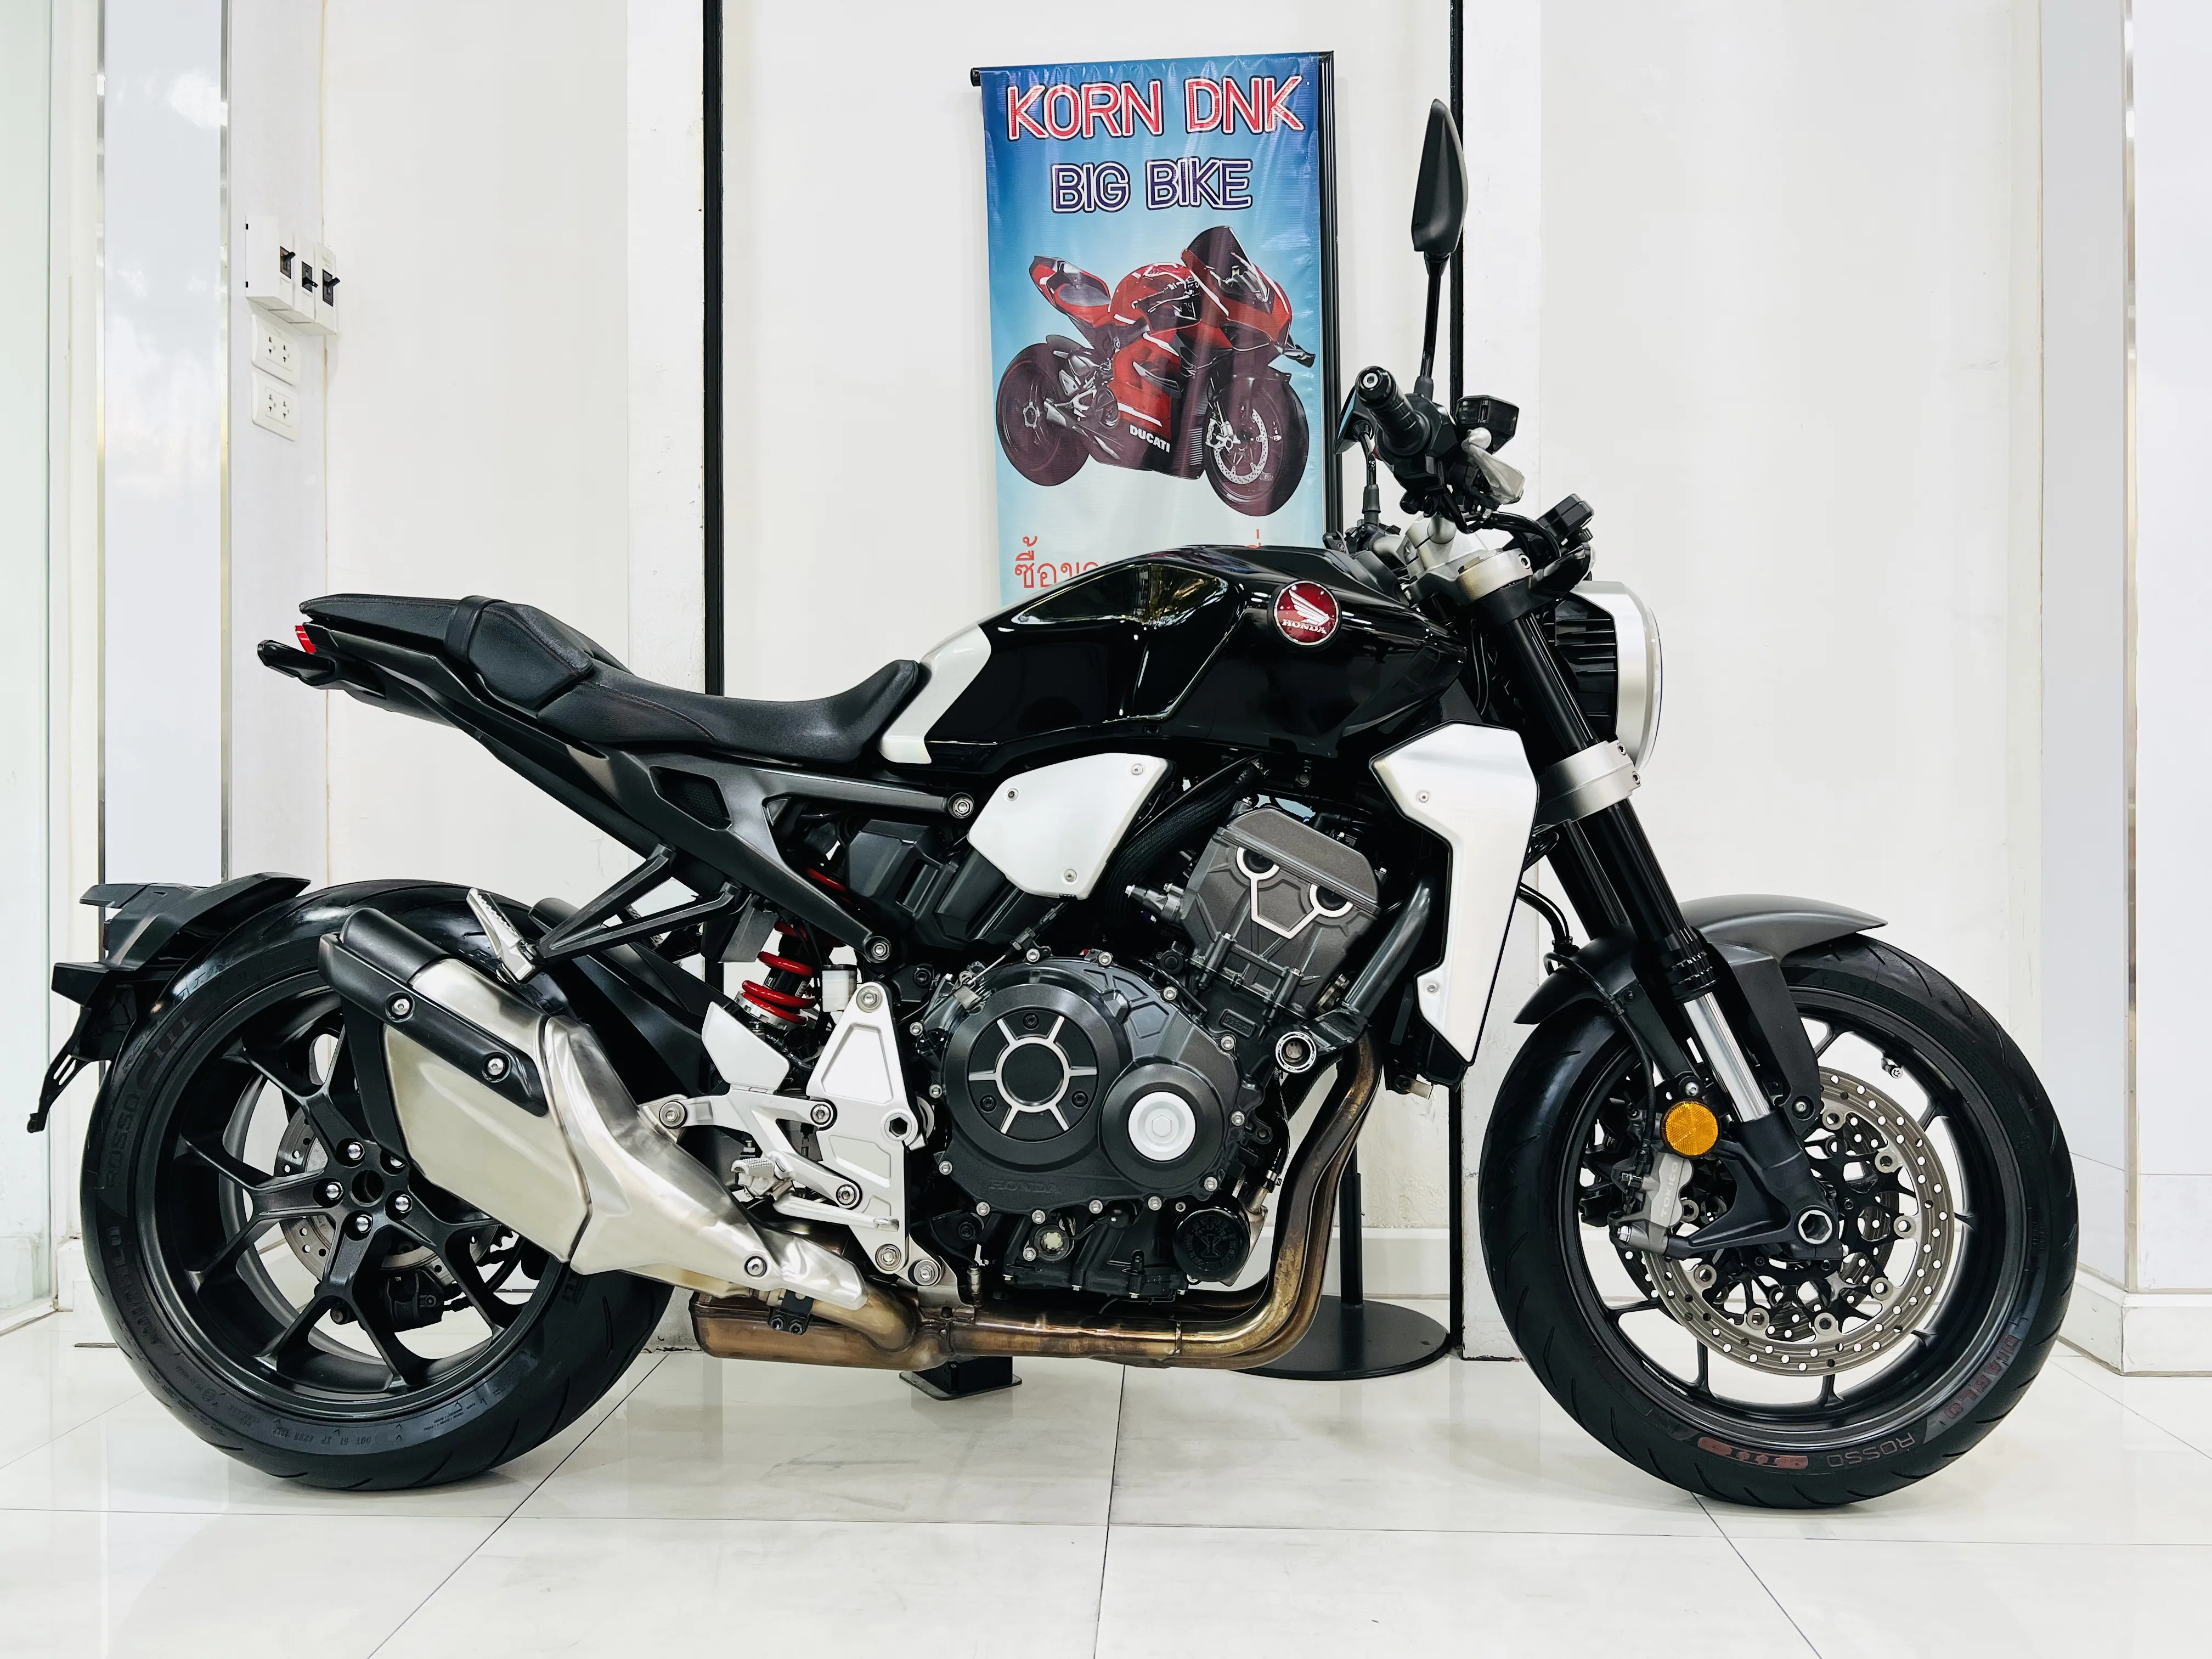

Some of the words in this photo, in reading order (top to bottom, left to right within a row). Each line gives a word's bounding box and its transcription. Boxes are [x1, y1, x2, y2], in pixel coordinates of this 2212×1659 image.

[1007, 79, 1164, 141] KORN
[1183, 74, 1306, 134] DNK
[1051, 161, 1130, 213] BIG
[1145, 157, 1252, 210] BIKE
[1130, 424, 1170, 453] DUCATI
[1282, 619, 1327, 634] HONDA
[988, 1180, 1062, 1194] HONDA
[1661, 1161, 1678, 1218] TOKICO
[1944, 1334, 2019, 1419] DIABLO
[1826, 1432, 1916, 1468] ROSSO
